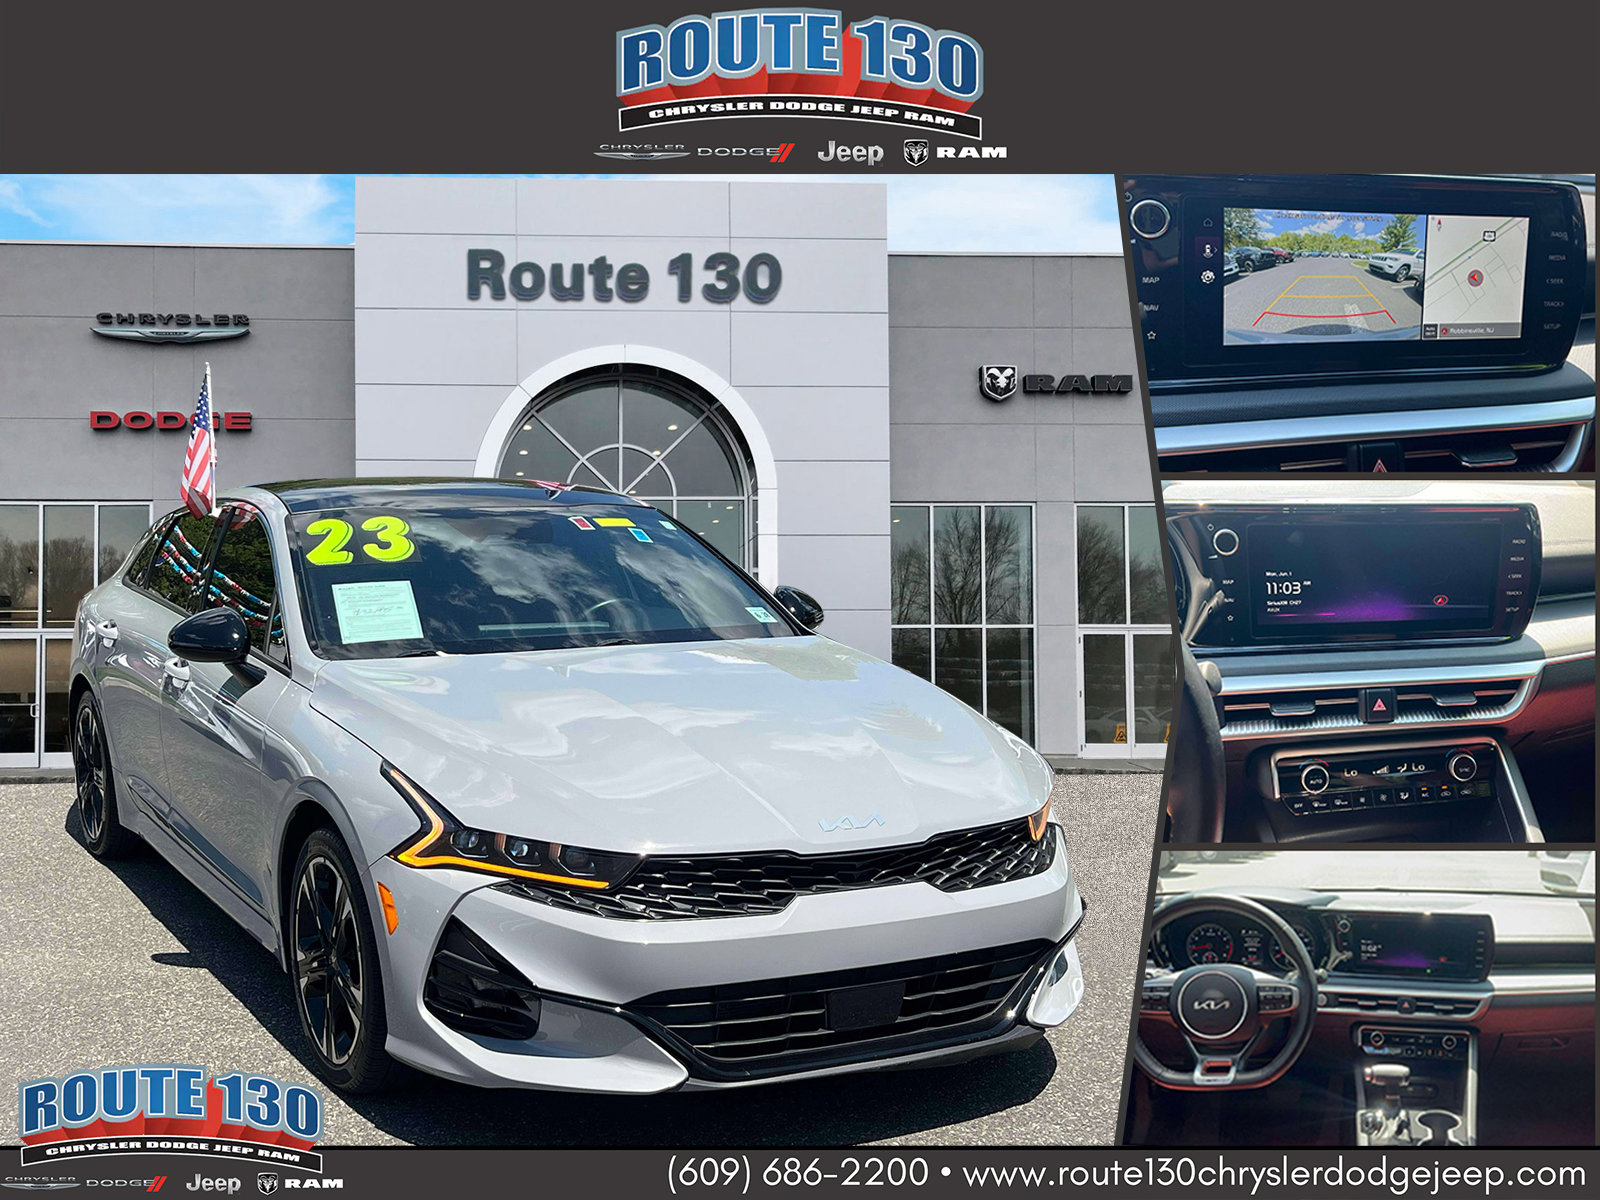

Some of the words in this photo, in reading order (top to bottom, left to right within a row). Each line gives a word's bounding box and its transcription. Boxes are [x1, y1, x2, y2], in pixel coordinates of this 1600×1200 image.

[467, 248, 650, 302] Route
[668, 252, 783, 304] 130
[1141, 276, 1161, 284] MAP
[96, 312, 251, 326] CHRYSLER
[1023, 374, 1134, 395] RAM
[306, 516, 415, 566] 23
[1265, 581, 1302, 595] 11:03
